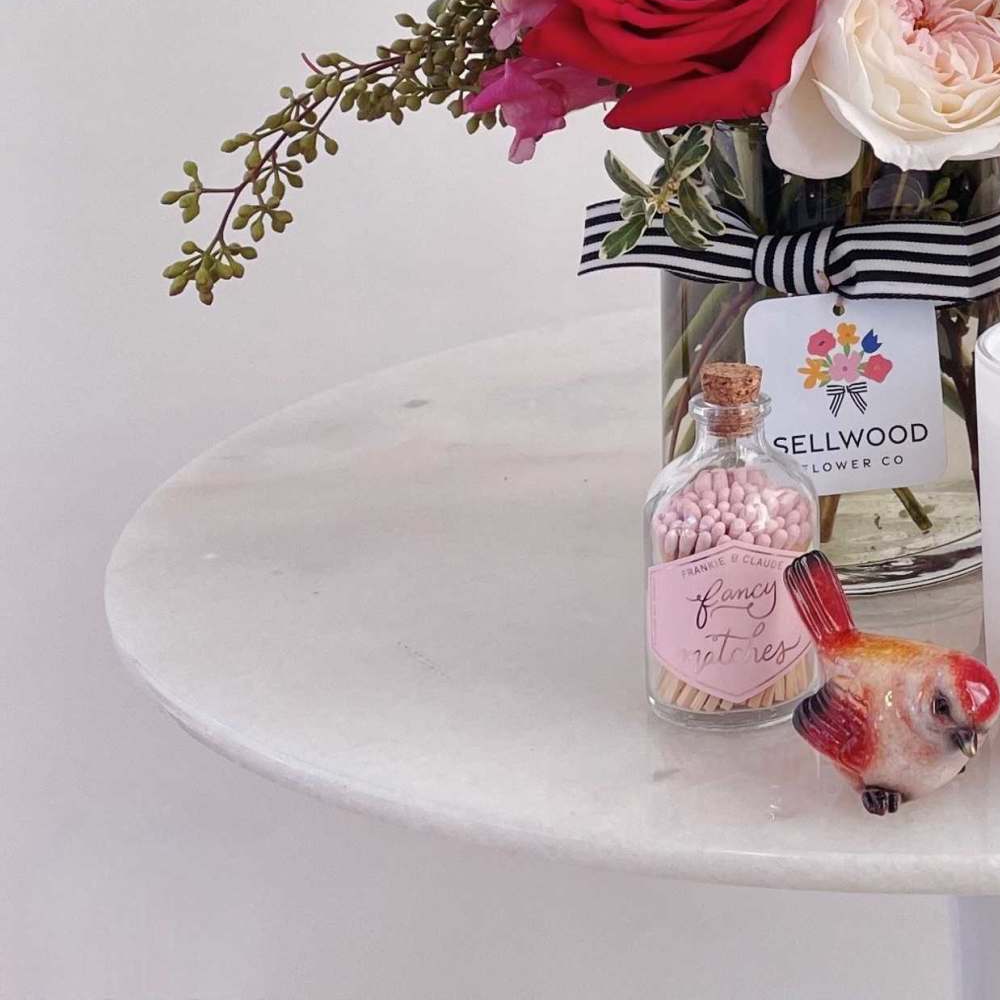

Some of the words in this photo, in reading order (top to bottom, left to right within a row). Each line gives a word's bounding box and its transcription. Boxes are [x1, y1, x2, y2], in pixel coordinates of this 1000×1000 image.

[773, 423, 928, 454] SELLWOOD
[881, 455, 903, 466] CO
[686, 579, 776, 629] fancy
